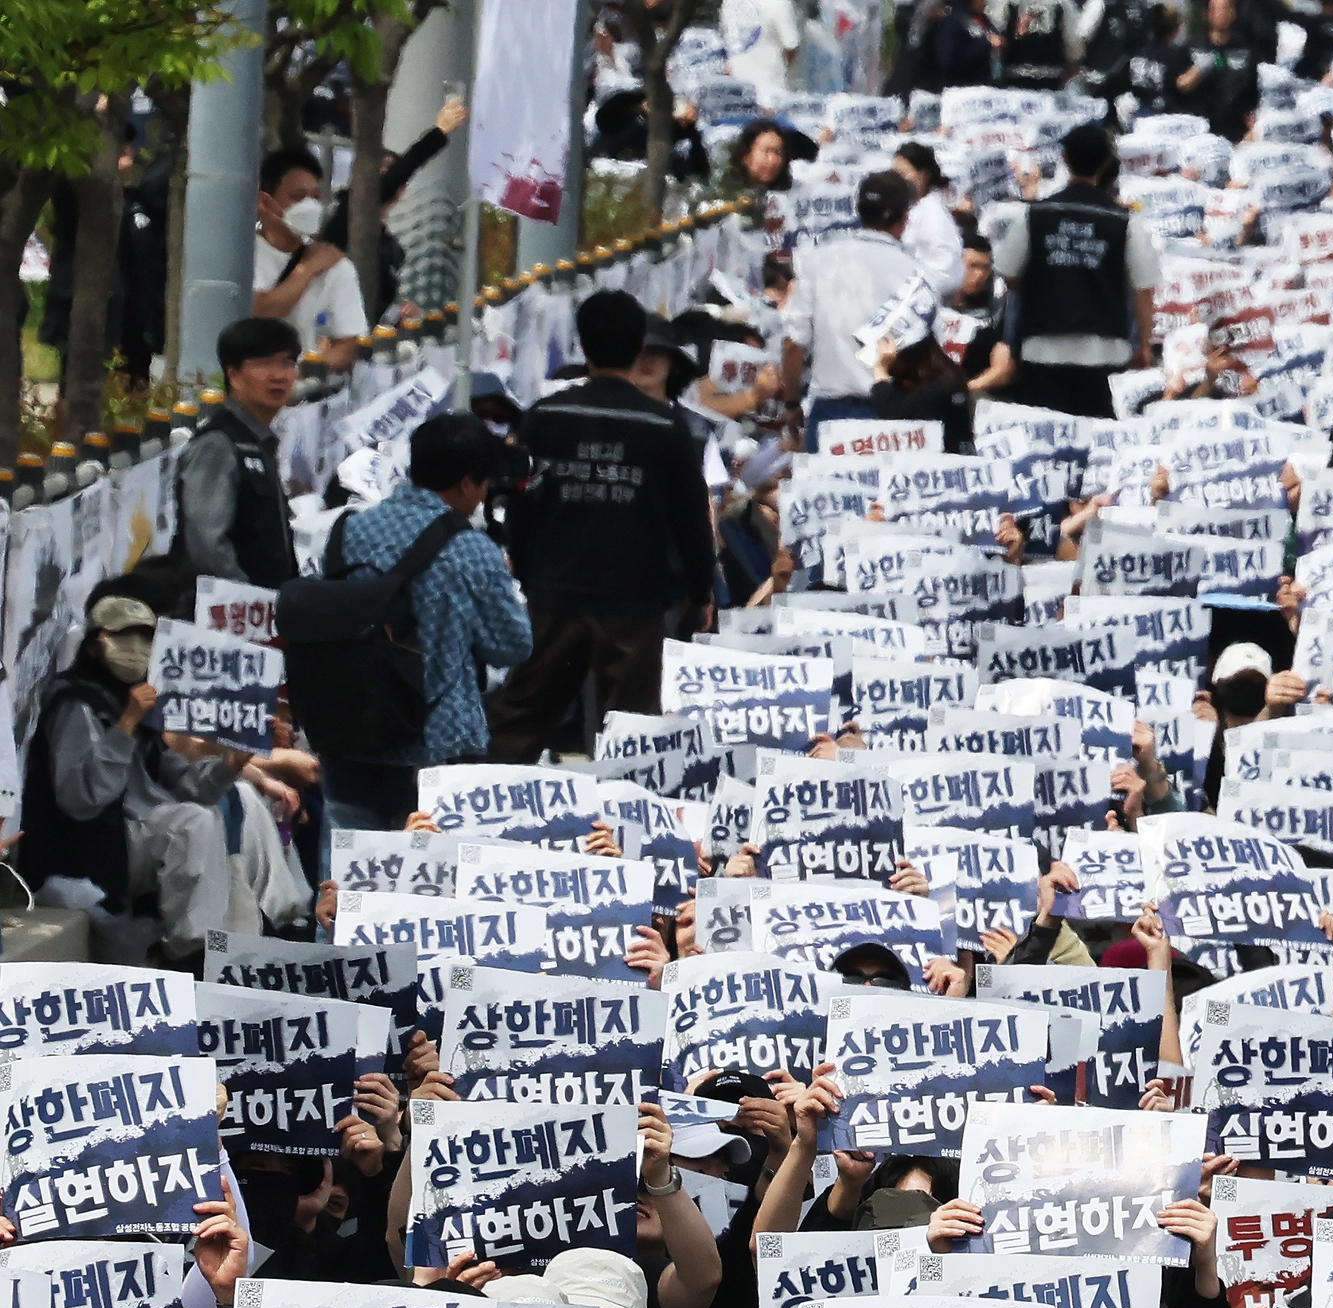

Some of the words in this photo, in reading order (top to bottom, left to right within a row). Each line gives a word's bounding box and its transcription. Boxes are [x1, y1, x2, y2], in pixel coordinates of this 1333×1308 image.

[888, 463, 993, 498] 상한폐지
[158, 648, 267, 683] 상한폐지
[674, 662, 809, 694] 상한폐지
[162, 699, 273, 734] 실현하자
[433, 778, 578, 834] 상한폐지
[762, 778, 894, 826] 상한폐지
[765, 840, 899, 881] 실현하자
[1163, 838, 1294, 878] 상한폐지
[765, 900, 916, 933] 상한폐지
[1175, 892, 1320, 931] 실현하자
[669, 959, 821, 1031] 상한폐지
[459, 994, 642, 1048] 상한폐지
[836, 1014, 1020, 1076] 상한폐지
[5, 1066, 188, 1156] 상한폐지
[425, 1114, 608, 1188] 상한폐지
[977, 1119, 1173, 1186] 상한폐지
[12, 1147, 222, 1238] 실현하자
[115, 1223, 180, 1233] 삼성전자노동조합
[441, 1192, 636, 1259] 실현하자
